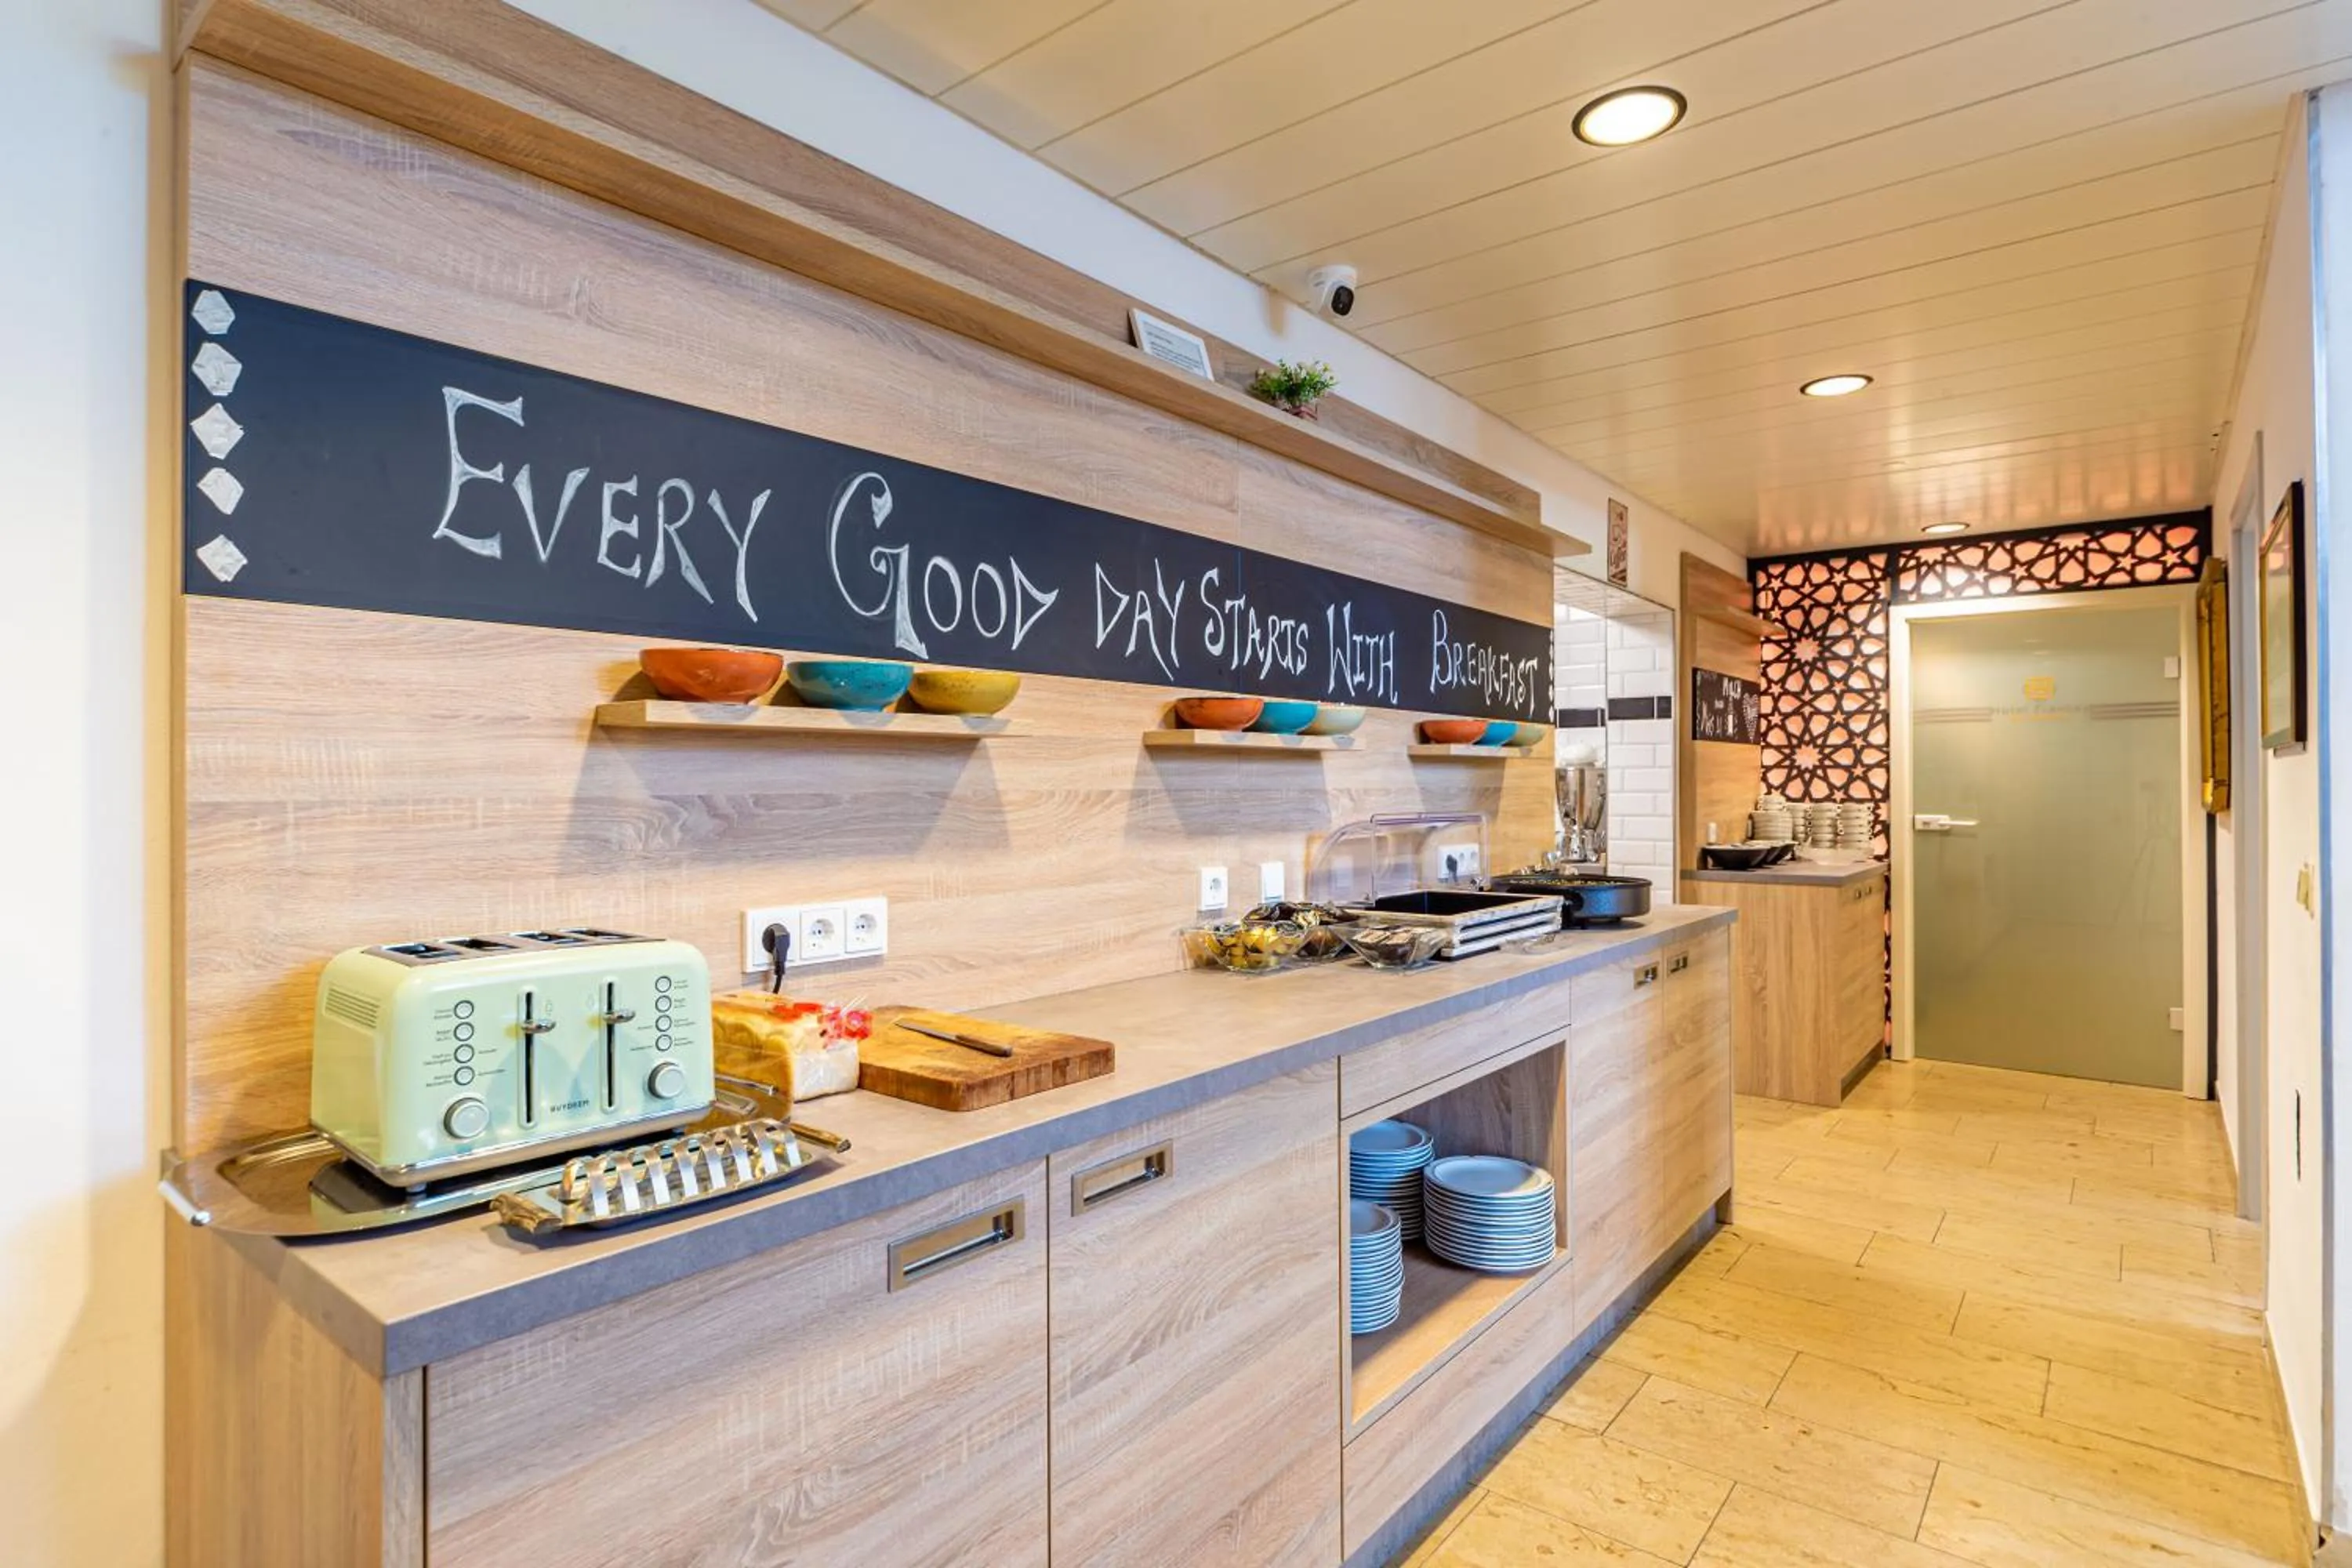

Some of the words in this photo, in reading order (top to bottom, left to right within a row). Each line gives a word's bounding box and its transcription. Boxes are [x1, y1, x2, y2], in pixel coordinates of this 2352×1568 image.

[432, 386, 771, 622] EVERY
[829, 472, 1059, 659] GOOD
[1095, 557, 1185, 681] DAY
[1200, 567, 1308, 681] STARTS
[1326, 601, 1397, 705] WITH
[1429, 609, 1538, 717] BREAKFAST
